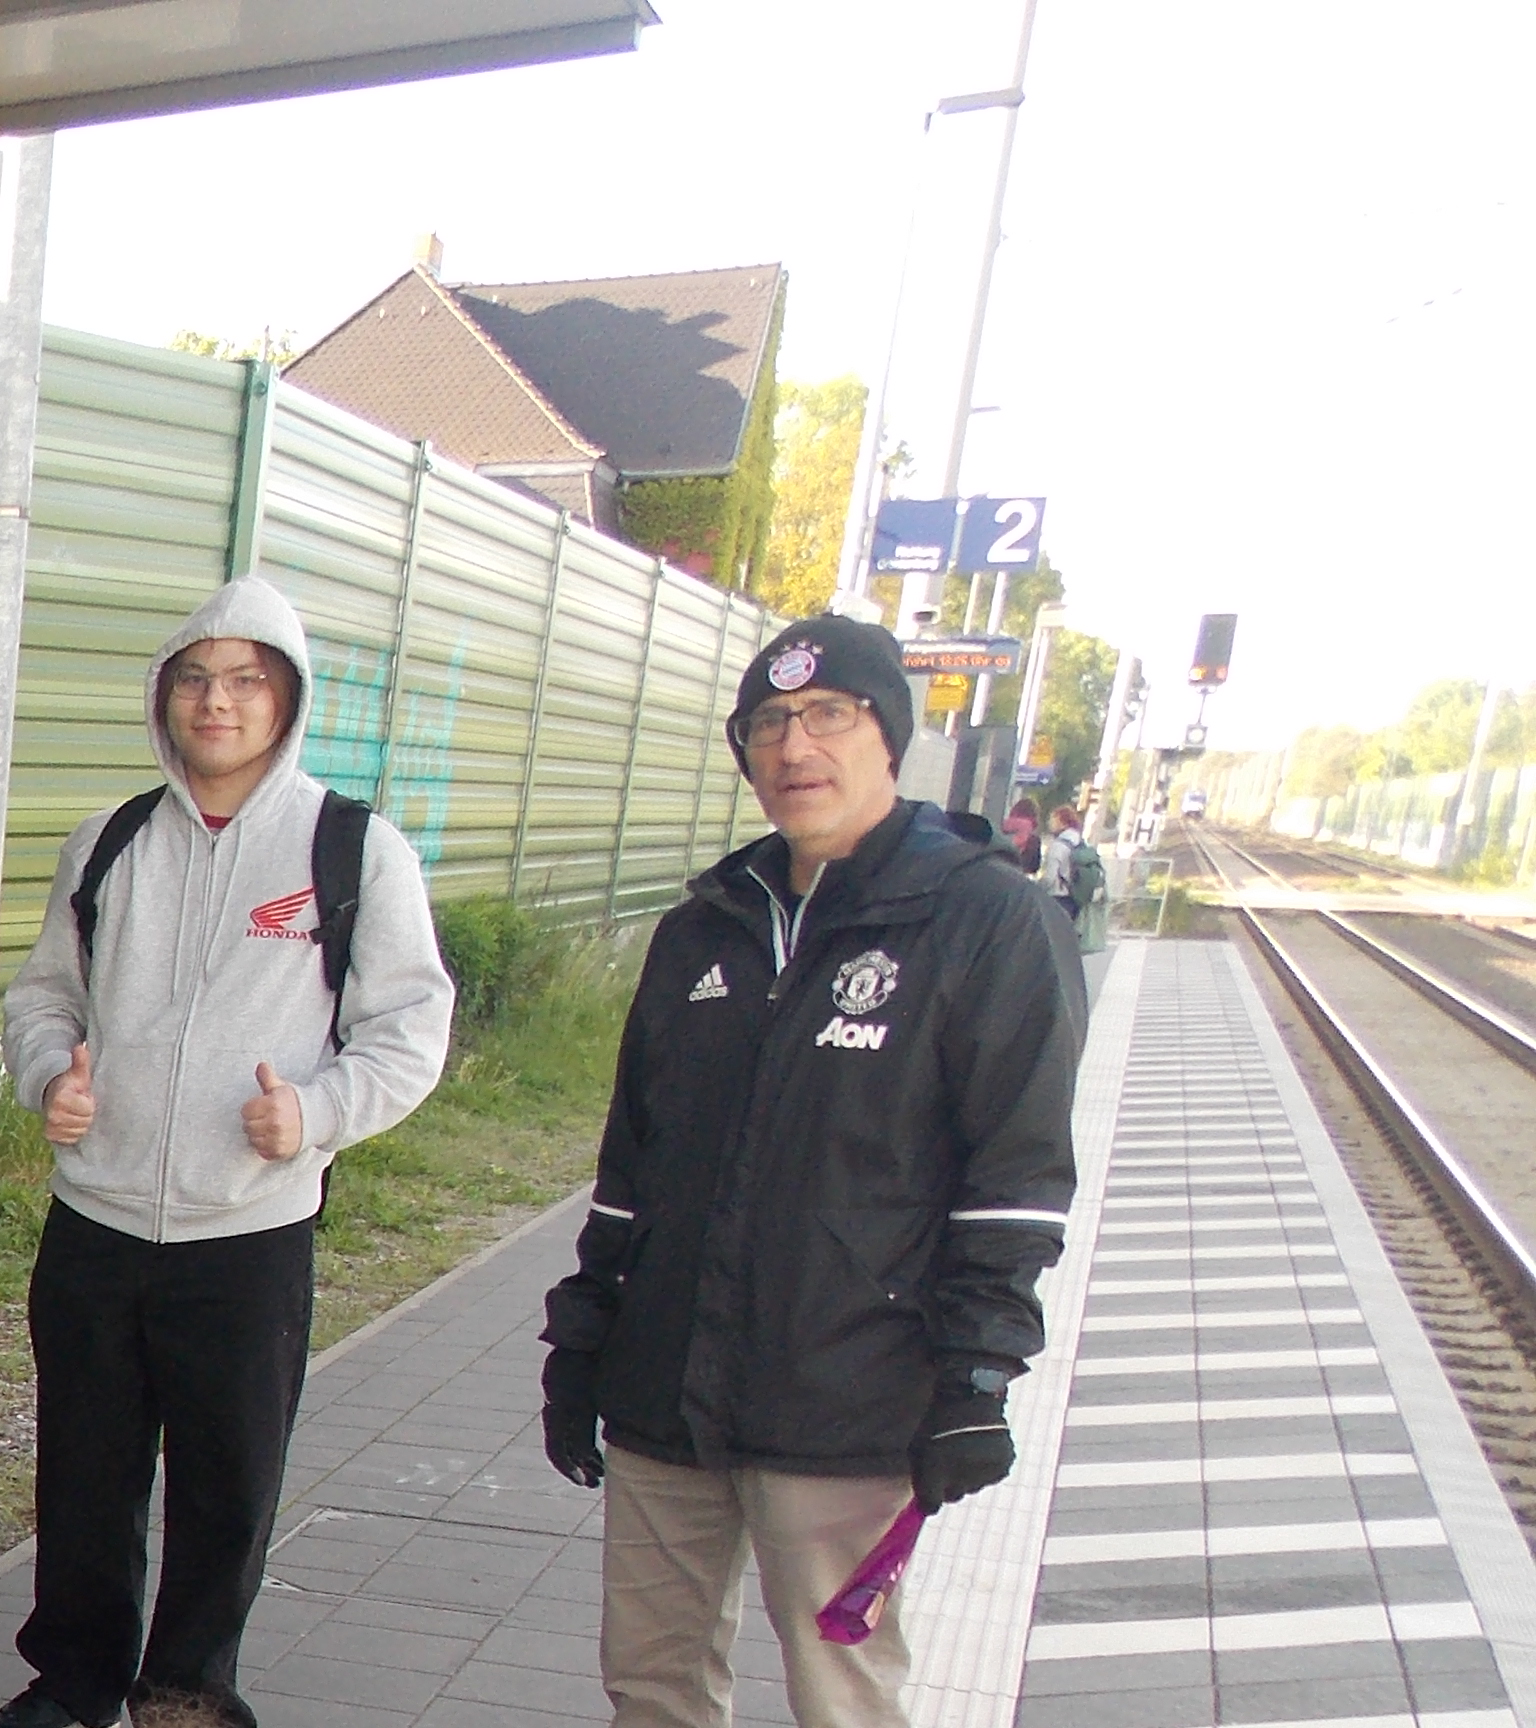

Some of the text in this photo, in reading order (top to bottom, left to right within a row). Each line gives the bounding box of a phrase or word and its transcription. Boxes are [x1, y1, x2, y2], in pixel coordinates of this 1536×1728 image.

[986, 499, 1037, 564] 2
[1134, 817, 1156, 844] H
[245, 927, 308, 941] HONDA
[688, 985, 729, 1002] adidas
